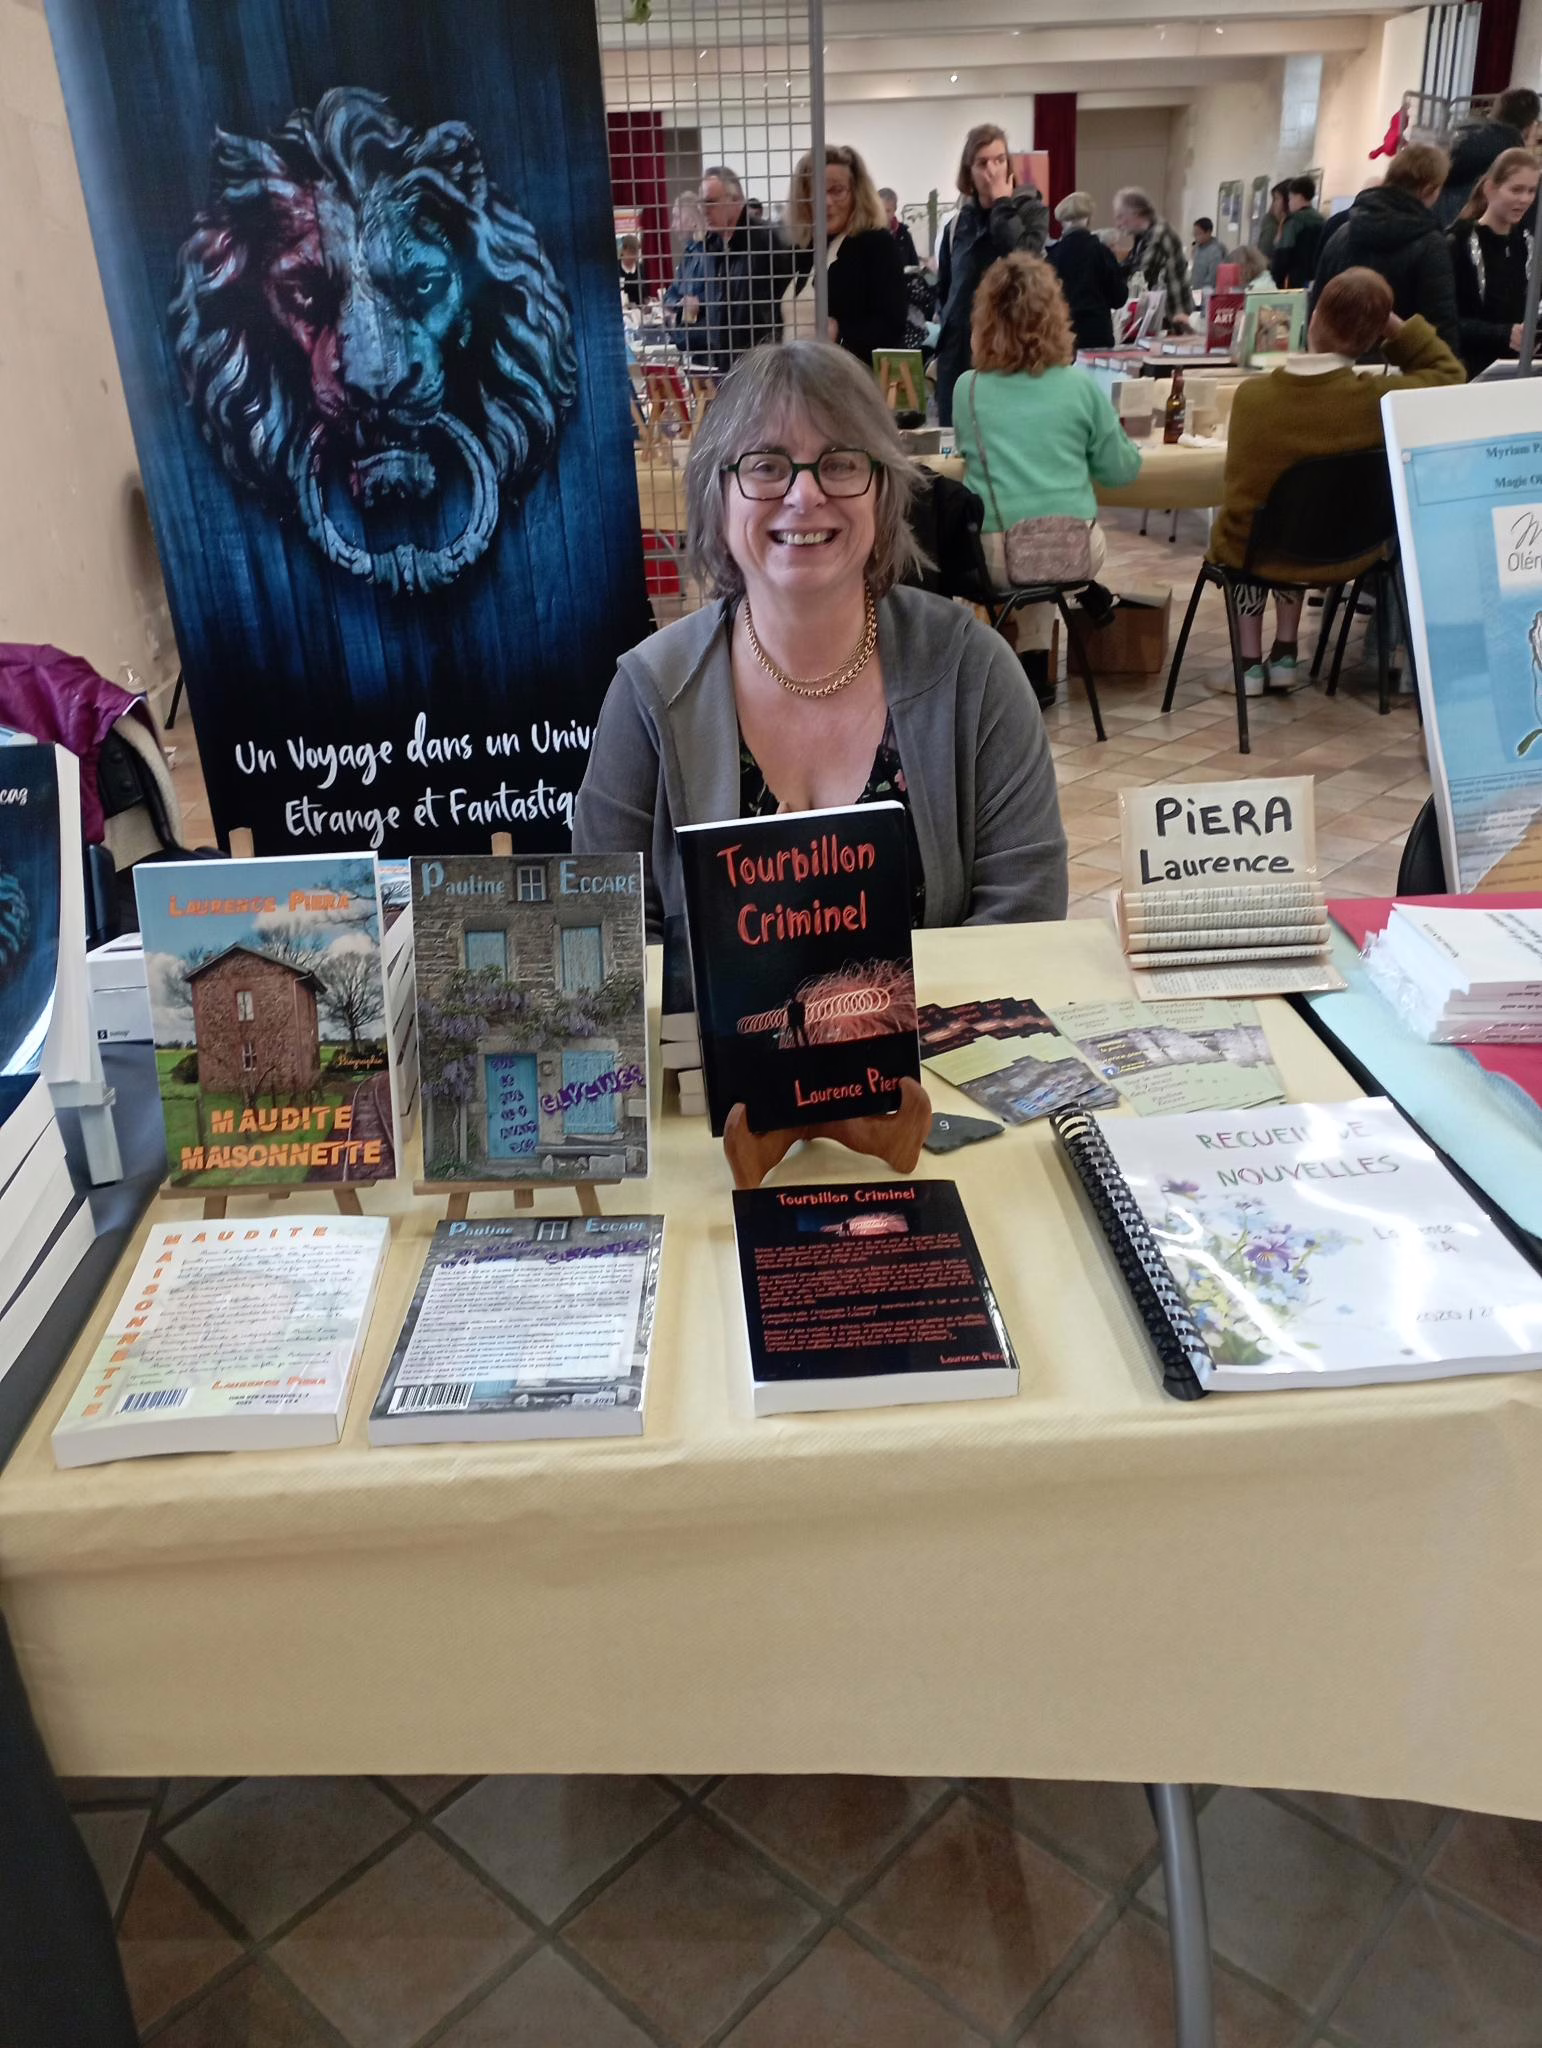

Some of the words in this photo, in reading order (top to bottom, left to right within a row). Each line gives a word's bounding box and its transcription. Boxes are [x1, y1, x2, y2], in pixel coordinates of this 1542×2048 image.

[1485, 443, 1530, 460] Myriam
[235, 740, 277, 775] Un
[286, 736, 393, 790] Voyage
[406, 711, 473, 768] dans
[486, 731, 520, 758] un
[531, 719, 598, 754] Univ
[285, 795, 400, 849] Etrange
[413, 786, 446, 828] et
[449, 778, 579, 832] Fantastiq
[716, 833, 875, 888] Tourbillon
[1139, 849, 1294, 885] Laurence
[421, 862, 505, 897] Pauline
[737, 890, 867, 945] Criminel
[541, 1064, 647, 1115] GLYCINES
[794, 1079, 863, 1107] Laurence
[866, 1067, 902, 1095] Pier
[211, 1105, 352, 1134] MAUDITE
[181, 1140, 383, 1170] MAISONNETTE
[1217, 1154, 1400, 1188] NOUVELLES
[776, 1190, 849, 1207] Tourbillon
[855, 1187, 916, 1204] Criminel
[163, 1226, 329, 1246] MAUDITE
